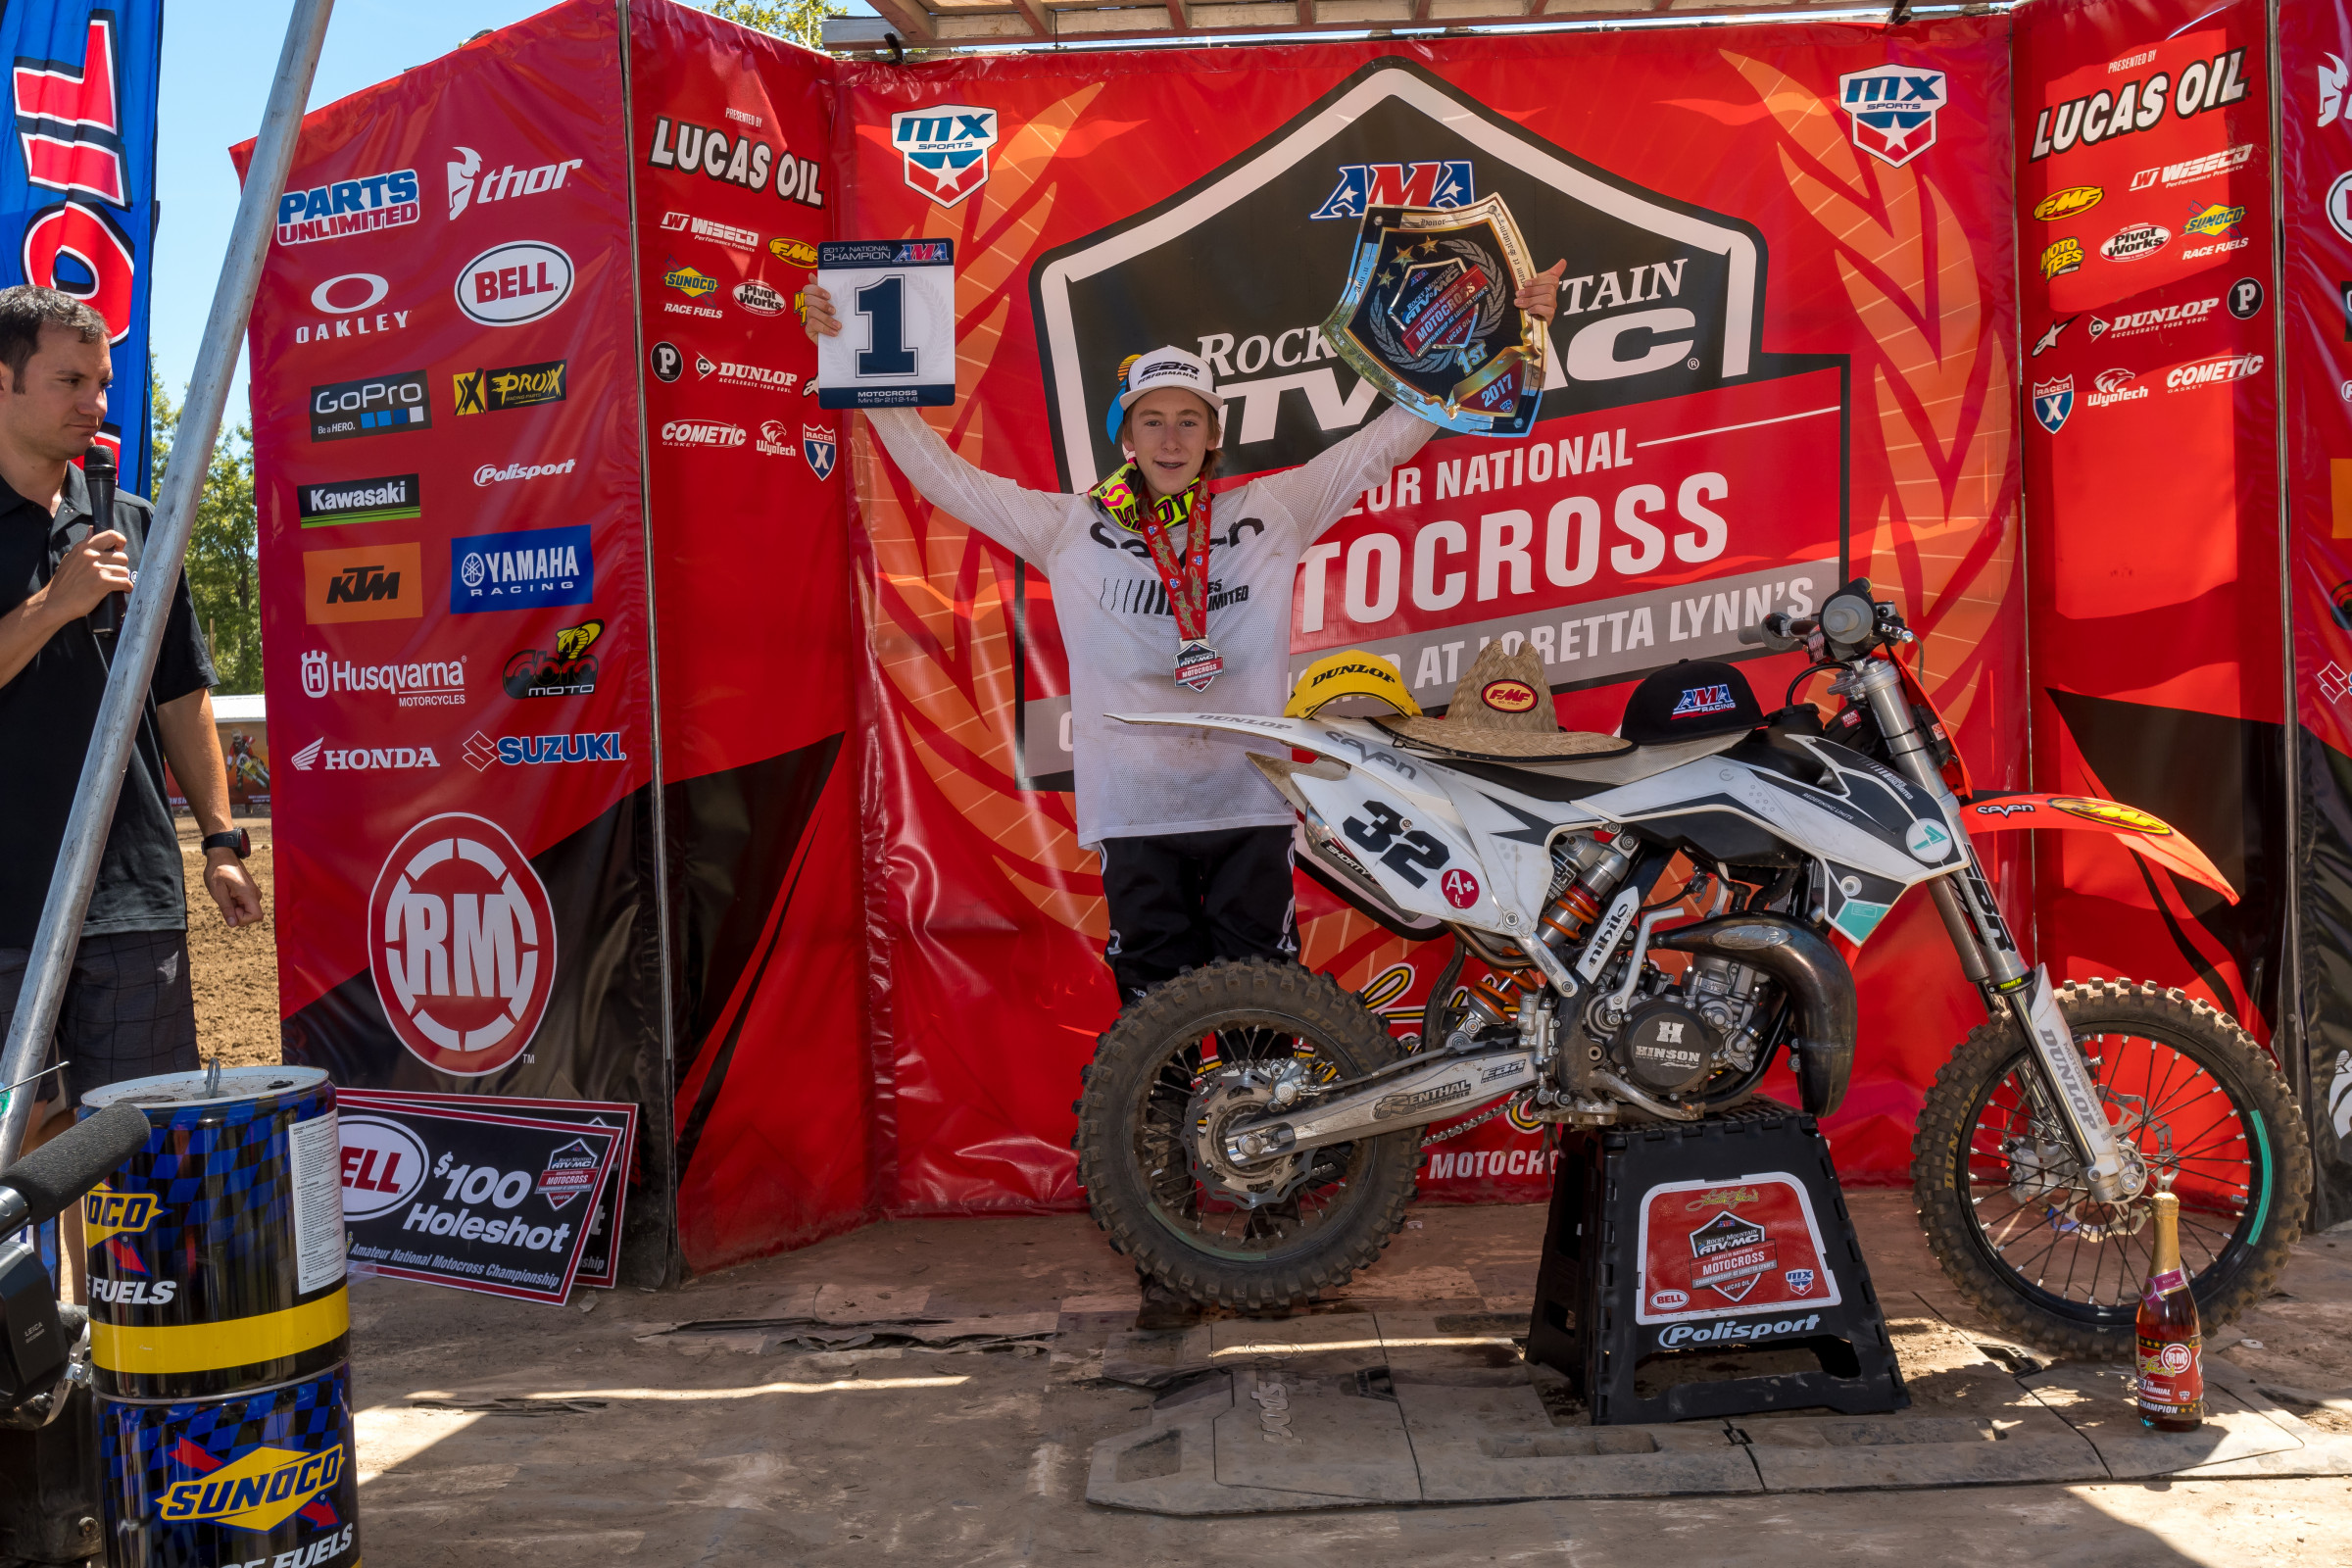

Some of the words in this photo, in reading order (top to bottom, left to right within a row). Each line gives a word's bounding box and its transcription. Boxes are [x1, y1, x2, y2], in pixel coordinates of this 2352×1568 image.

[2108, 52, 2146, 74] PRESENTED
[2148, 49, 2157, 62] BY
[1844, 75, 1943, 103] MX
[725, 107, 756, 126] PRESENTED
[755, 117, 763, 128] BY
[2030, 73, 2170, 164] LUCAS
[2176, 46, 2251, 120] OIL
[896, 114, 995, 141] MX
[918, 141, 973, 150] SPORTS
[648, 115, 772, 193] LUCAS
[775, 151, 824, 210] OIL
[476, 158, 583, 204] thor
[2166, 173, 2211, 188] Performance
[2213, 164, 2244, 177] Products
[278, 171, 418, 224] PARTS
[1309, 161, 1475, 220] AMA
[2034, 187, 2103, 220] FMF
[278, 203, 418, 243] UNLIMITED
[2187, 208, 2243, 232] SUNOCO
[694, 235, 731, 248] Performance
[731, 242, 756, 253] Products
[2107, 236, 2165, 257] Works
[2114, 227, 2157, 246] Pivot
[2182, 245, 2213, 261] RACE
[2215, 237, 2249, 253] FUELS
[823, 252, 891, 262] CHAMPION
[893, 243, 949, 263] AMA
[2040, 238, 2079, 272] MOTO
[2045, 249, 2084, 281] TEES
[474, 262, 555, 304] BELL
[666, 272, 715, 292] SUNOCO
[744, 284, 777, 300] Pivot
[664, 303, 692, 316] RACE
[693, 306, 723, 319] FUELS
[739, 293, 782, 311] Works
[1406, 291, 1425, 310] ROCKY
[1415, 282, 1476, 342] MOTOCROSS
[296, 311, 410, 343] OAKLEY
[855, 273, 918, 379] 1
[2111, 297, 2220, 331] DUNLOP
[1446, 325, 1463, 344] LUCAS
[1462, 318, 1471, 327] OIL
[2111, 325, 2160, 339] ACCELERATE
[2163, 319, 2182, 329] YOUR
[1197, 324, 1338, 377] ROCK
[1457, 341, 1488, 374] 1ST
[718, 362, 798, 386] DUNLOP
[718, 377, 759, 388] ACCELERATE
[1138, 371, 1199, 385] PERFORMANCE
[2167, 355, 2264, 388] COMETIC
[316, 383, 421, 414] GoPro
[1481, 373, 1514, 408] 2017
[2036, 382, 2070, 396] RACER
[2087, 386, 2148, 408] WyoTech
[2168, 384, 2203, 394] GASKET
[2043, 395, 2064, 423] X
[318, 425, 326, 435] Be
[662, 421, 747, 446] COMETIC
[806, 431, 833, 442] RACER
[756, 439, 796, 457] WyoTech
[813, 443, 830, 470] X
[473, 459, 576, 486] Polisport
[1437, 427, 1633, 499] NATIONAL
[310, 480, 406, 512] Kawasaki
[485, 546, 580, 583] YAMAHA
[1297, 471, 1730, 633] TOCROSS
[325, 564, 401, 604] KTM
[470, 581, 574, 597] RACING
[1415, 641, 1461, 689] AT
[1669, 576, 1815, 644] LYNN'S
[333, 658, 465, 695] Husqvarna
[1182, 663, 1217, 678] MOTOCROSS
[1311, 663, 1396, 687] DUNLOP
[398, 695, 466, 708] MOTORCYCLES
[1489, 688, 1532, 702] FMF
[1673, 683, 1735, 713] AMA
[1700, 702, 1736, 713] RACING
[1195, 714, 1293, 731] DUNLOP
[324, 747, 441, 771] HONDA
[497, 731, 622, 765] SUZUKI
[1802, 792, 1836, 812] REDEFINING
[1835, 808, 1854, 821] LIMITS
[1342, 800, 1450, 889] 32
[1326, 844, 1370, 876] SHORTY
[408, 893, 517, 998] RM
[1636, 1045, 1701, 1062] HINSON
[2039, 1028, 2098, 1130] DUNLOP
[2063, 1042, 2104, 1125] MOTORSPORTS
[340, 1146, 402, 1195] ELL
[433, 1151, 532, 1209] $100
[546, 1175, 589, 1185] MOTOCROSS
[403, 1202, 570, 1253] Holeshot
[1706, 1237, 1725, 1246] ROCKY
[1726, 1229, 1757, 1241] MOUNTAIN
[350, 1243, 391, 1260] Amateur
[390, 1248, 431, 1266] National
[431, 1254, 484, 1276] Motocross
[486, 1263, 560, 1289] Championship
[1702, 1250, 1765, 1276] MOTOCROSS
[92, 1277, 176, 1304] FUELS
[1695, 1272, 1732, 1286] CHAMPIONSHIP
[1724, 1283, 1740, 1292] LUCAS
[1656, 1294, 1684, 1304] BELL
[24, 1321, 43, 1337] LEICA
[1658, 1314, 1820, 1348] Polisport
[2168, 1352, 2185, 1365] RM
[2146, 1384, 2171, 1396] ANNUAL
[2139, 1398, 2178, 1414] CHAMPION
[165, 1452, 341, 1521] SUNOCO
